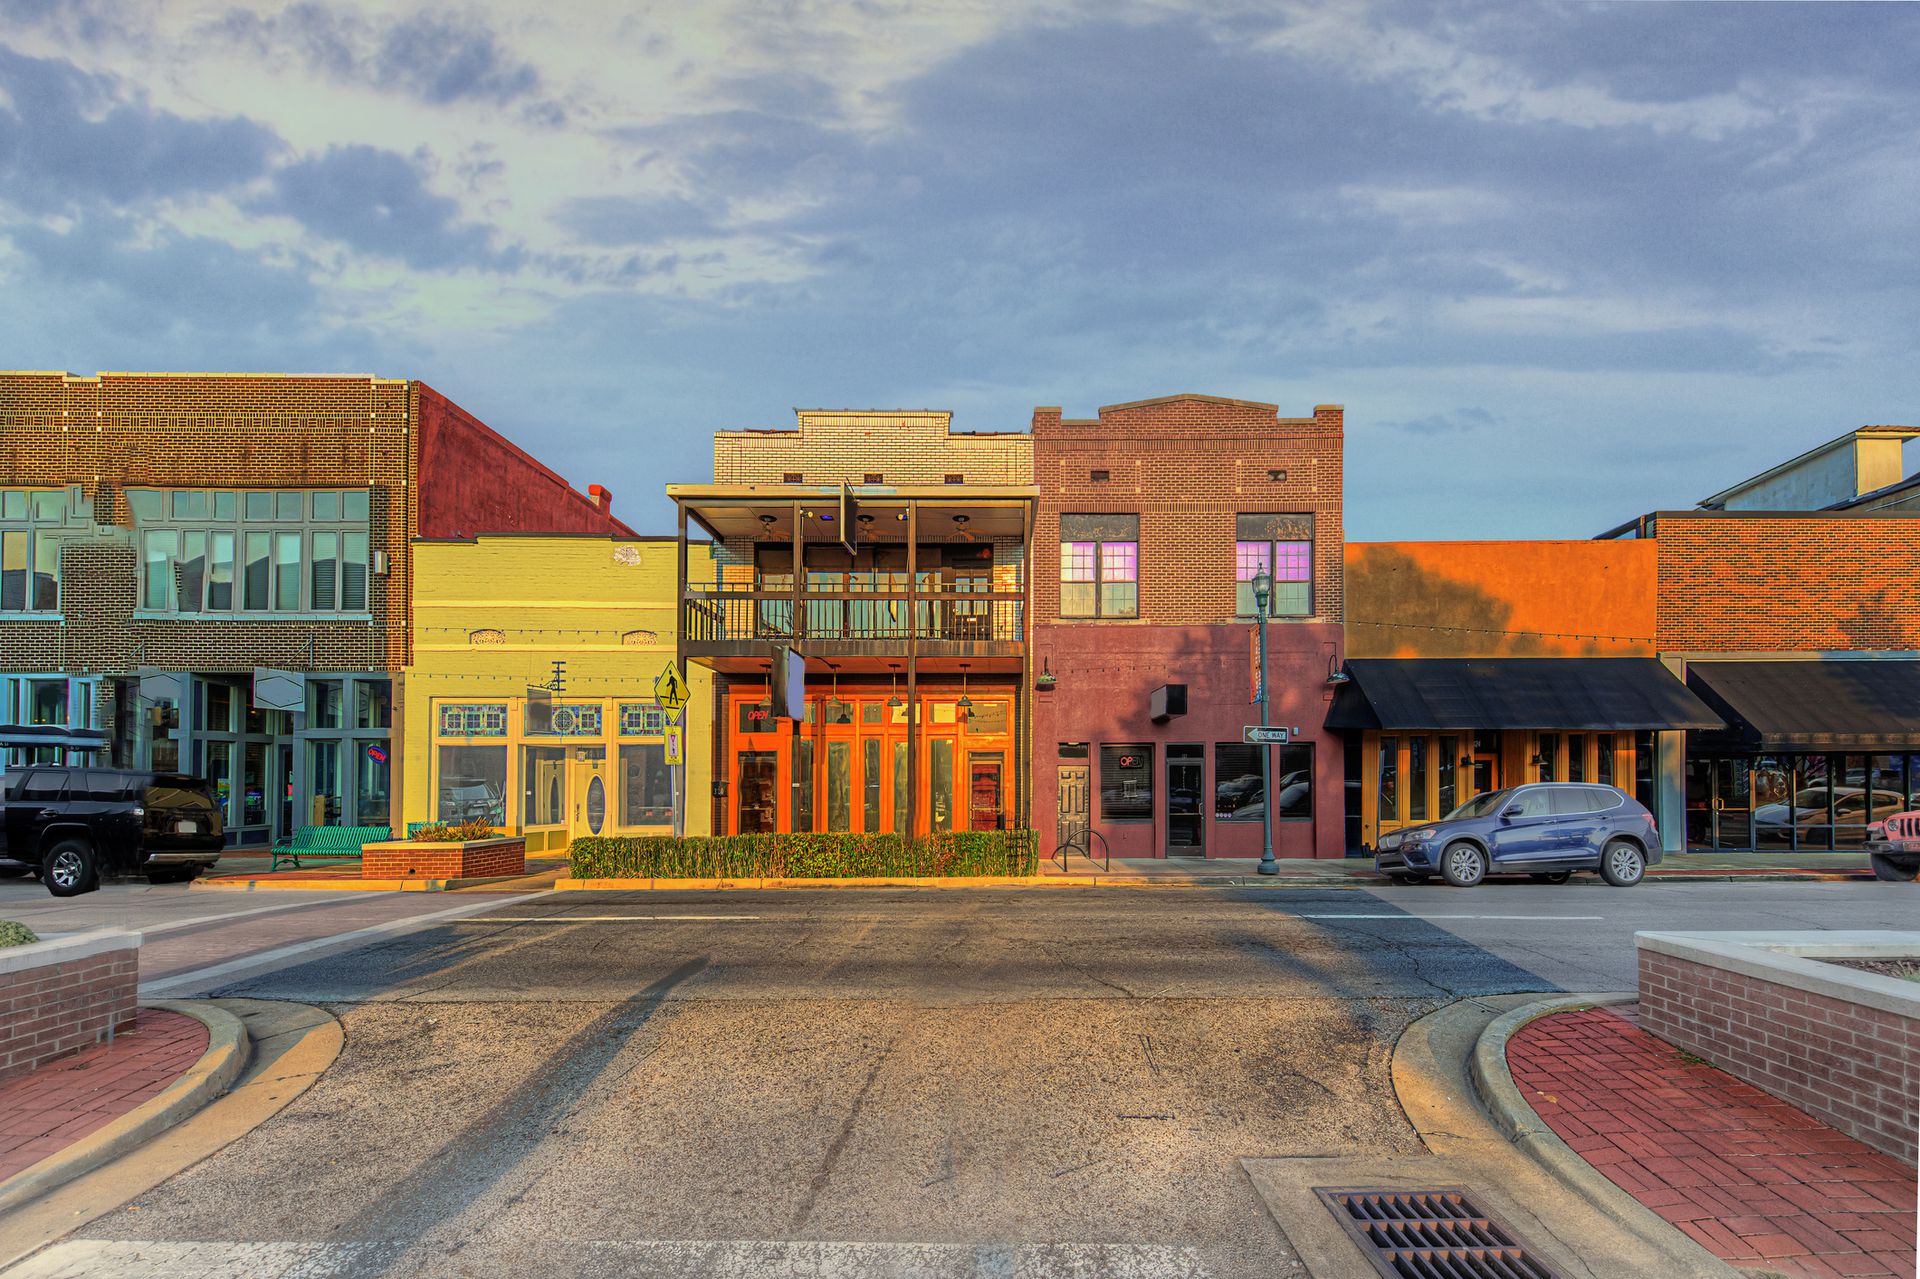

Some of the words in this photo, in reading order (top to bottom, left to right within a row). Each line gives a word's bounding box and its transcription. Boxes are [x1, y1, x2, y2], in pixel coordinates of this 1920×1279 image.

[747, 710, 769, 720] OPEN
[1257, 731, 1270, 739] ONE
[367, 748, 386, 763] OPEN
